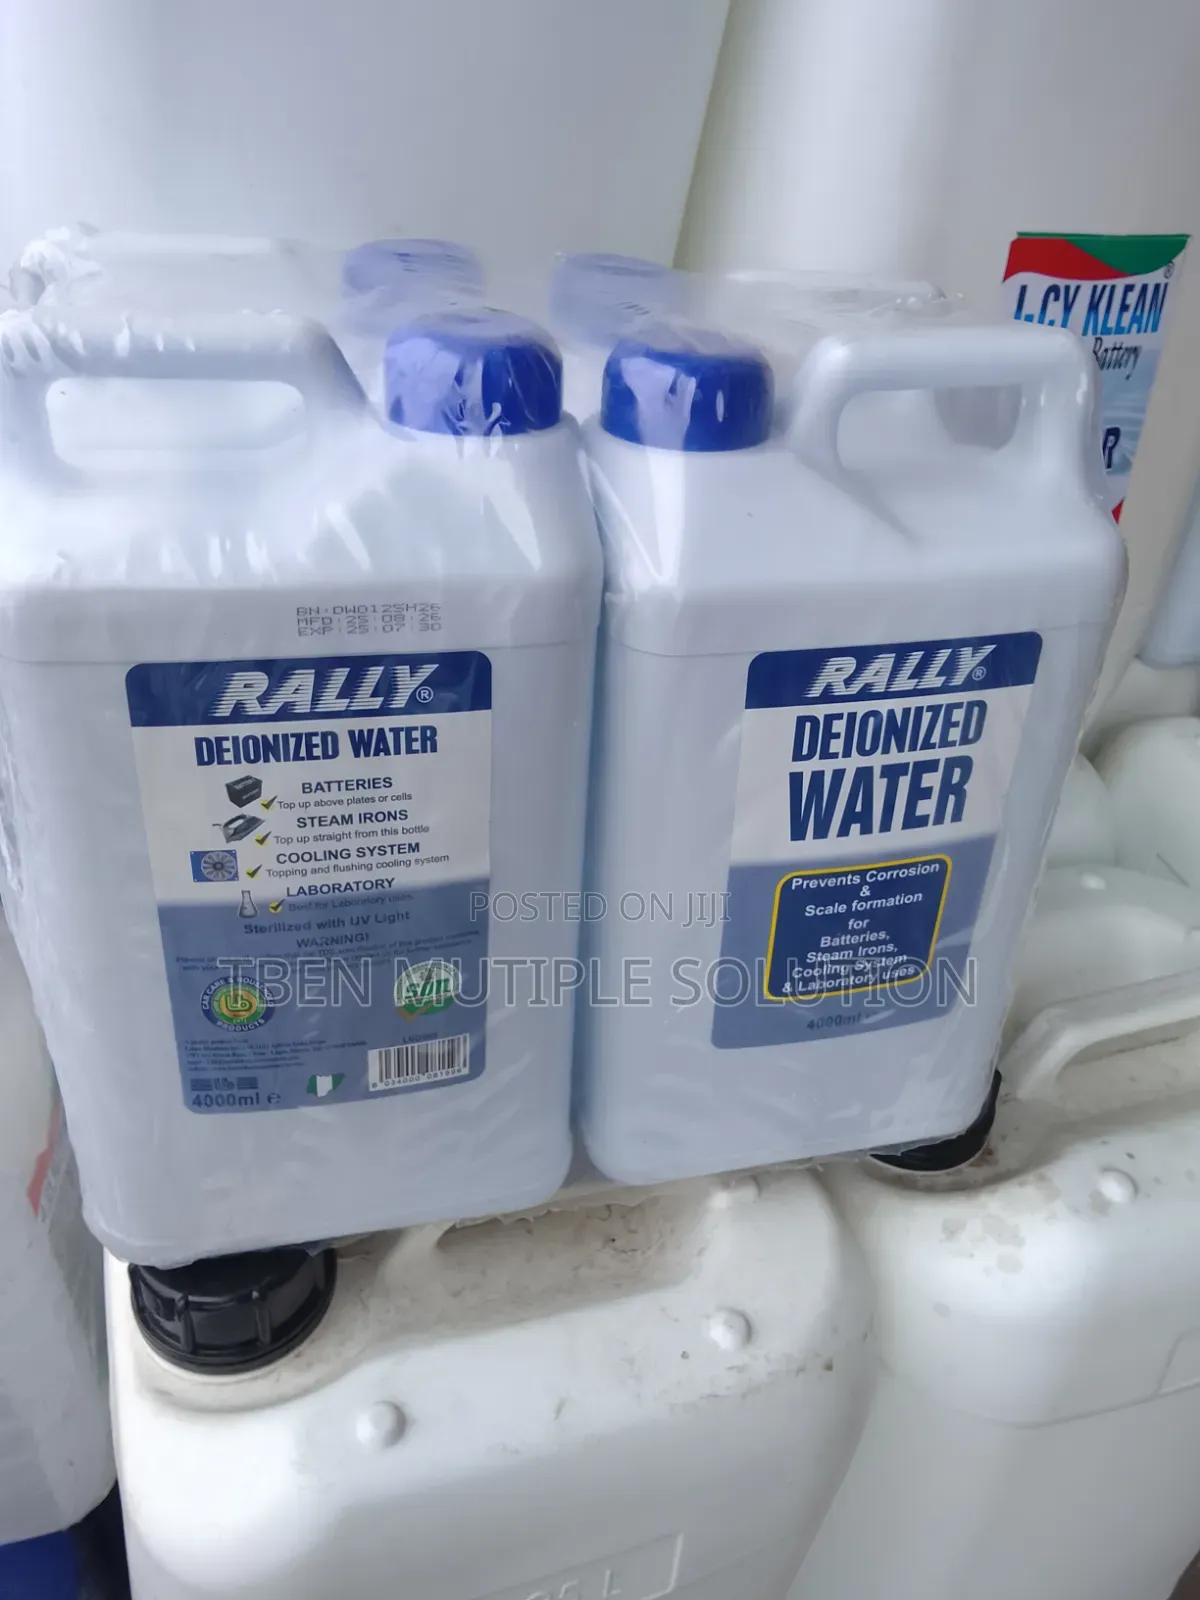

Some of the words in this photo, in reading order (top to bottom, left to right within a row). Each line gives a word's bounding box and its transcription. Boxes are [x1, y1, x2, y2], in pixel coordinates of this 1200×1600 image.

[1081, 282, 1168, 336] KLEAN
[791, 700, 988, 763] DEIONIZED
[194, 730, 340, 766] DEIONIZED
[347, 724, 438, 758] WATER
[301, 776, 393, 795] BATTERIES
[278, 800, 295, 811] Top
[298, 800, 311, 811] up
[314, 796, 344, 808] above
[347, 794, 376, 807] plates
[378, 794, 389, 803] or
[390, 792, 413, 802] cells
[788, 755, 974, 842] WATER
[296, 813, 354, 829] STEAM
[358, 809, 409, 825] IRONS
[274, 834, 294, 846] Top
[296, 834, 310, 845] up
[312, 829, 352, 843] straight
[354, 827, 379, 839] from
[380, 826, 399, 837] this
[402, 823, 430, 835] bottle
[276, 848, 352, 864] COOLING
[356, 842, 420, 858] SYSTEM
[266, 867, 308, 879] Topping
[310, 864, 330, 875] and
[333, 861, 374, 874] flushing
[375, 857, 412, 870] cooling
[414, 853, 450, 866] system
[791, 873, 861, 890] Prevents
[865, 862, 940, 883] Corrosion
[286, 876, 396, 898] LABORATORY
[859, 885, 871, 897] &
[804, 902, 847, 917] Scale
[851, 892, 923, 912] formation
[244, 919, 312, 935] Sterilized
[316, 917, 346, 929] with
[350, 915, 371, 926] UV
[374, 909, 412, 925] Light
[848, 918, 870, 930] for
[820, 930, 890, 948] Batteries,
[806, 949, 853, 963] Steam
[857, 942, 898, 957] Irons,
[792, 963, 851, 980] Cooling
[854, 954, 908, 972] System
[782, 981, 793, 993] &
[798, 972, 878, 992] Laboratory
[882, 966, 915, 980] uses
[191, 1092, 260, 1108] 4000ml
